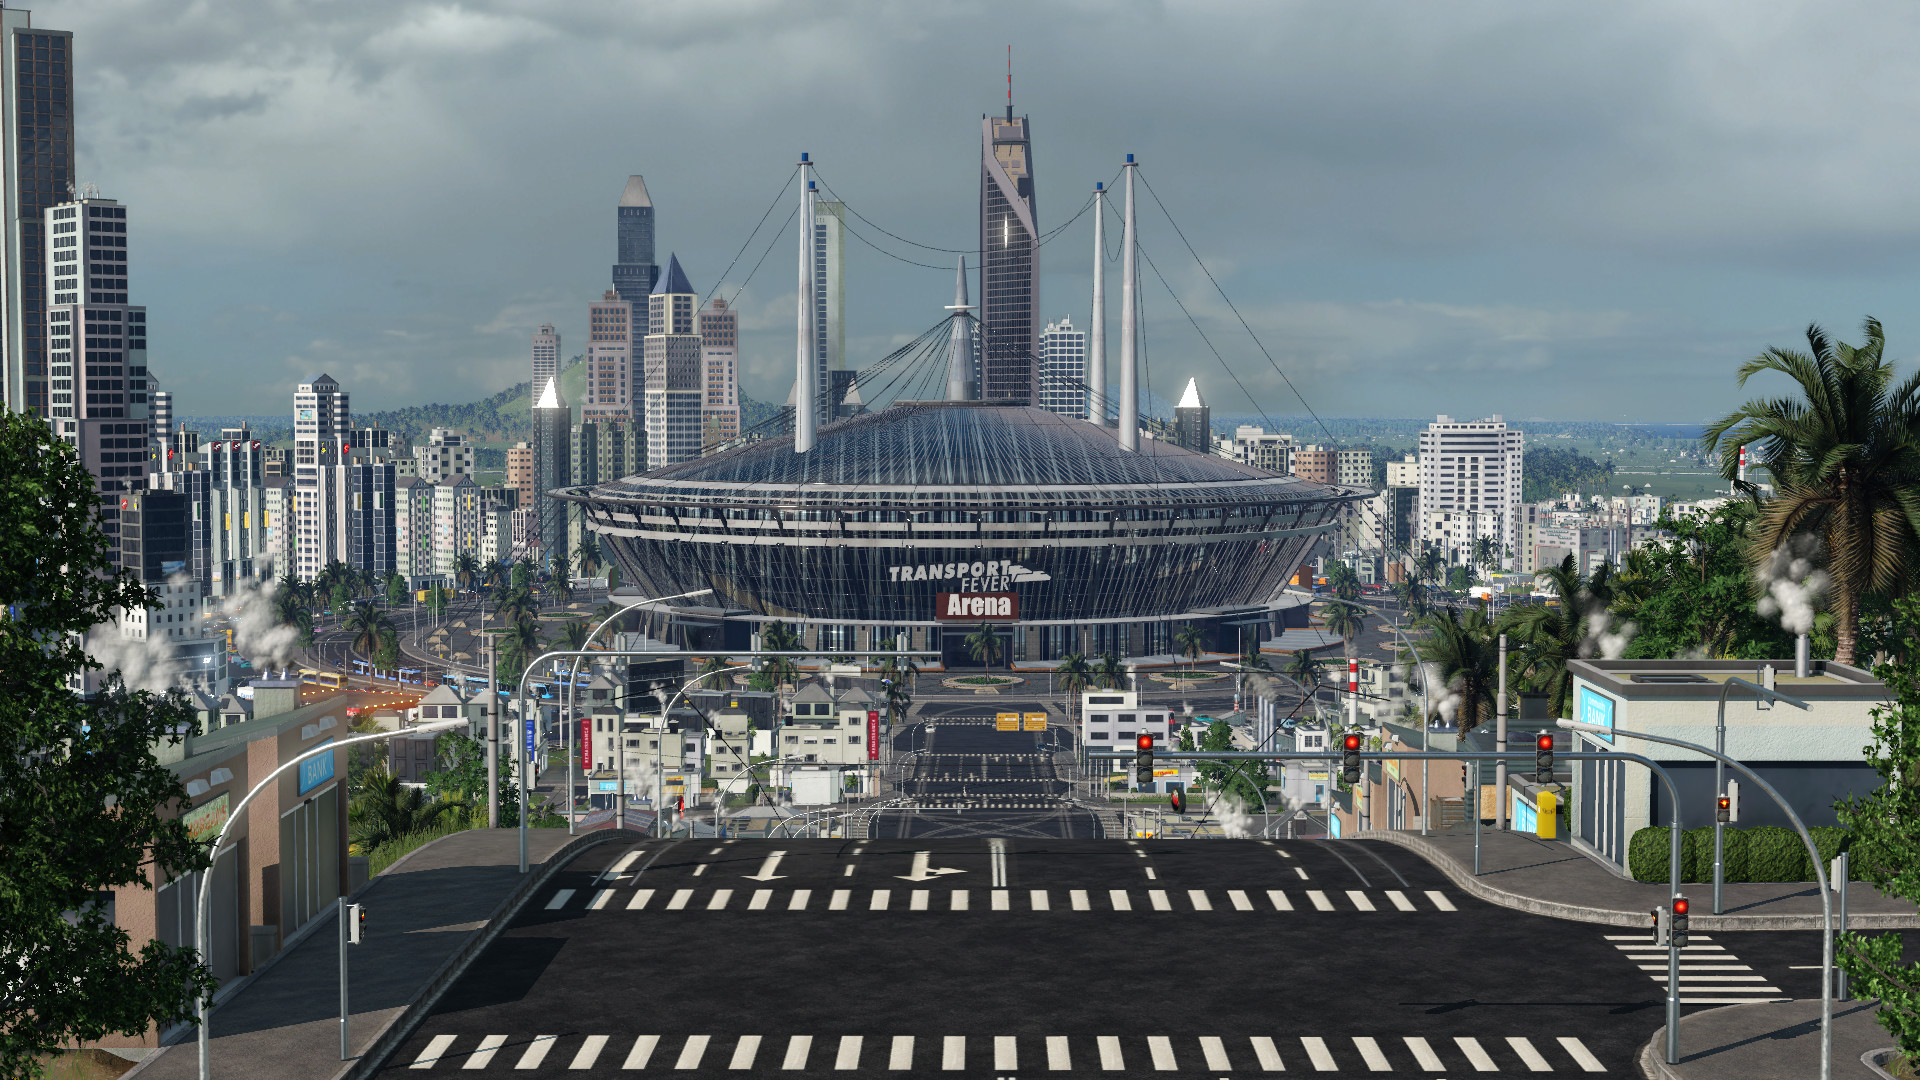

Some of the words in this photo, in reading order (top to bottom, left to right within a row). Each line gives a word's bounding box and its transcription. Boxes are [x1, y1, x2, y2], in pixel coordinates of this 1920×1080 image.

[889, 560, 1012, 582] TRANSPORT
[961, 576, 1010, 593] FEVER
[947, 594, 1011, 616] Arena
[1587, 705, 1605, 726] BANK
[308, 757, 327, 784] BANK
